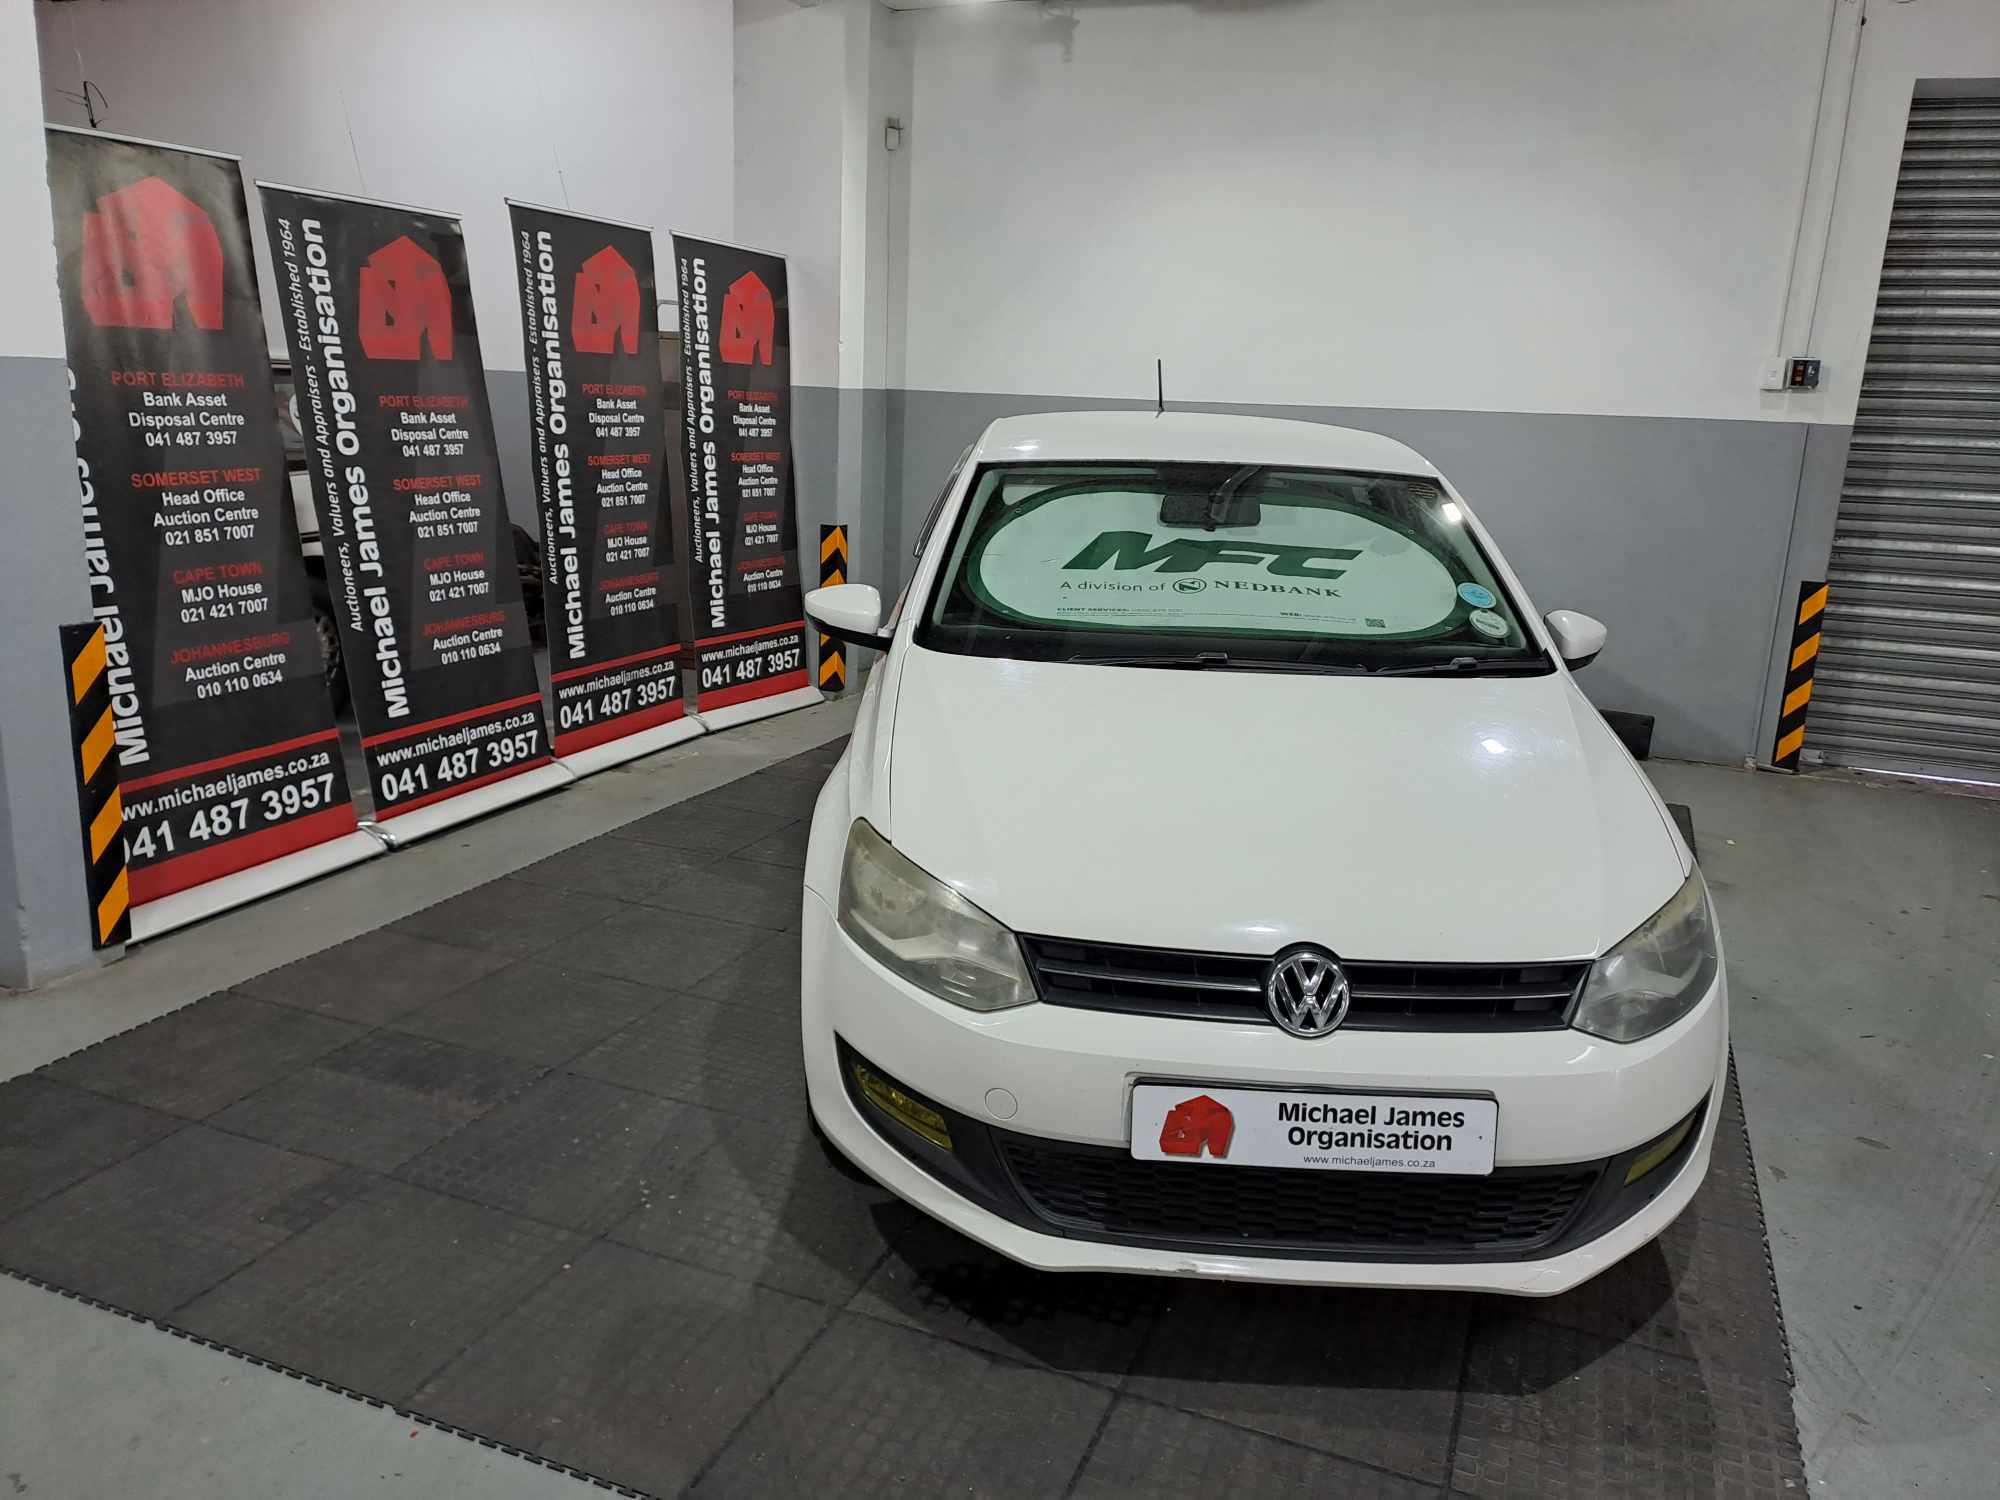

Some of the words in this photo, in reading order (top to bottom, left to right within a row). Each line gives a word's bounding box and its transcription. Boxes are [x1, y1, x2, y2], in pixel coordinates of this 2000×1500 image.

[278, 218, 296, 258] 1964
[520, 230, 532, 264] 1964
[680, 258, 688, 288] 1964
[283, 261, 313, 352] Established
[524, 267, 538, 346] Established
[537, 230, 567, 436] Organisation
[682, 288, 692, 356] Established
[302, 218, 360, 456] Organisation
[692, 258, 714, 434] Organisation
[112, 371, 156, 386] PORT
[161, 372, 245, 388] ELIZABETH
[532, 355, 547, 426] Appraisers
[143, 392, 182, 406] Bank
[186, 392, 228, 406] Asset
[305, 364, 330, 442] Appraisers
[596, 398, 615, 410] Bank
[616, 398, 637, 410] Asset
[686, 365, 696, 426] Appraisers
[128, 412, 196, 430] Disposal
[200, 412, 245, 426] Centre
[400, 412, 428, 424] Bank
[430, 412, 456, 424] Asset
[588, 412, 620, 425] Disposal
[622, 412, 645, 424] Centre
[145, 432, 171, 446] 041
[176, 431, 200, 446] 487
[206, 431, 238, 446] 3957
[391, 428, 436, 442] Disposal
[439, 428, 469, 440] Centre
[536, 427, 547, 453] and
[596, 426, 609, 438] 041
[610, 426, 624, 438] 487
[687, 426, 696, 448] and
[316, 448, 334, 478] and
[402, 444, 420, 458] 041
[423, 444, 441, 456] 487
[444, 444, 464, 456] 3957
[131, 470, 218, 488] SOMERSET
[222, 468, 262, 482] WEST
[393, 476, 452, 490] SOMERSET
[454, 474, 482, 486] WEST
[540, 454, 552, 504] Valuers
[602, 468, 620, 480] Head
[621, 468, 642, 479] Office
[689, 450, 698, 494] Valuers
[703, 440, 720, 524] James
[162, 491, 200, 506] Head
[203, 488, 246, 504] Office
[414, 492, 442, 506] Head
[443, 490, 471, 504] Office
[554, 443, 576, 539] James
[596, 482, 624, 495] Auction
[625, 481, 648, 492] Centre
[326, 482, 344, 537] Valuers
[408, 509, 448, 524] Auction
[450, 506, 481, 520] Centre
[602, 496, 614, 508] 021
[154, 511, 210, 527] Auction
[214, 507, 260, 522] Centre
[345, 466, 384, 578] James
[418, 525, 435, 538] 021
[437, 523, 455, 536] 851
[457, 521, 478, 534] 7007
[165, 531, 190, 546] 021
[194, 528, 220, 543] 851
[224, 524, 255, 540] 7007
[545, 507, 558, 585] Auctioneers,
[608, 536, 623, 549] MJO
[624, 536, 648, 547] House
[1060, 530, 1364, 580] MFC
[173, 569, 216, 584] CAPE
[220, 561, 262, 578] TOWN
[430, 573, 451, 586] MJO
[453, 568, 485, 582] House
[706, 531, 726, 628] Michael
[181, 586, 214, 603] MJO
[217, 582, 262, 598] House
[338, 542, 364, 632] Auctioneers,
[430, 589, 446, 602] 021
[449, 586, 466, 599] 421
[468, 582, 490, 596] 7007
[605, 590, 634, 604] Auction
[634, 587, 657, 599] Centre
[1060, 582, 1072, 590] A
[1078, 580, 1143, 592] division
[1148, 582, 1166, 592] of
[1214, 580, 1343, 598] NEDBANK
[180, 607, 205, 623] 021
[209, 603, 234, 618] 421
[238, 598, 268, 614] 7007
[560, 546, 586, 660] Michael
[364, 586, 410, 718] Michael
[433, 634, 470, 652] Auction
[471, 628, 503, 642] Centre
[441, 652, 458, 665] 010
[460, 647, 477, 660] 110
[478, 642, 501, 658] 0634
[701, 634, 799, 662] www.michaeljames.co.za
[185, 662, 240, 682] Auction
[243, 653, 286, 670] Centre
[558, 660, 674, 700] www.michaeljames.co.za
[702, 664, 730, 688] 041
[736, 656, 762, 680] 487
[768, 648, 800, 673] 3957
[197, 682, 220, 698] 010
[225, 678, 249, 692] 110
[252, 670, 283, 688] 0634
[560, 698, 594, 728] 041
[600, 688, 632, 716] 487
[637, 676, 676, 706] 3957
[376, 712, 535, 768] www.michaeljames.co.za
[381, 763, 429, 802] 041
[437, 747, 479, 782] 487
[486, 729, 538, 768] 3957
[122, 752, 330, 822] ww.michaeljames.co.za
[189, 798, 249, 841] 487
[260, 772, 335, 821] 3957
[1278, 1102, 1376, 1126] Michael
[1384, 1105, 1466, 1128] James
[1288, 1127, 1452, 1154] Organisation
[1303, 1154, 1436, 1168] www.michaeljames.co.za
